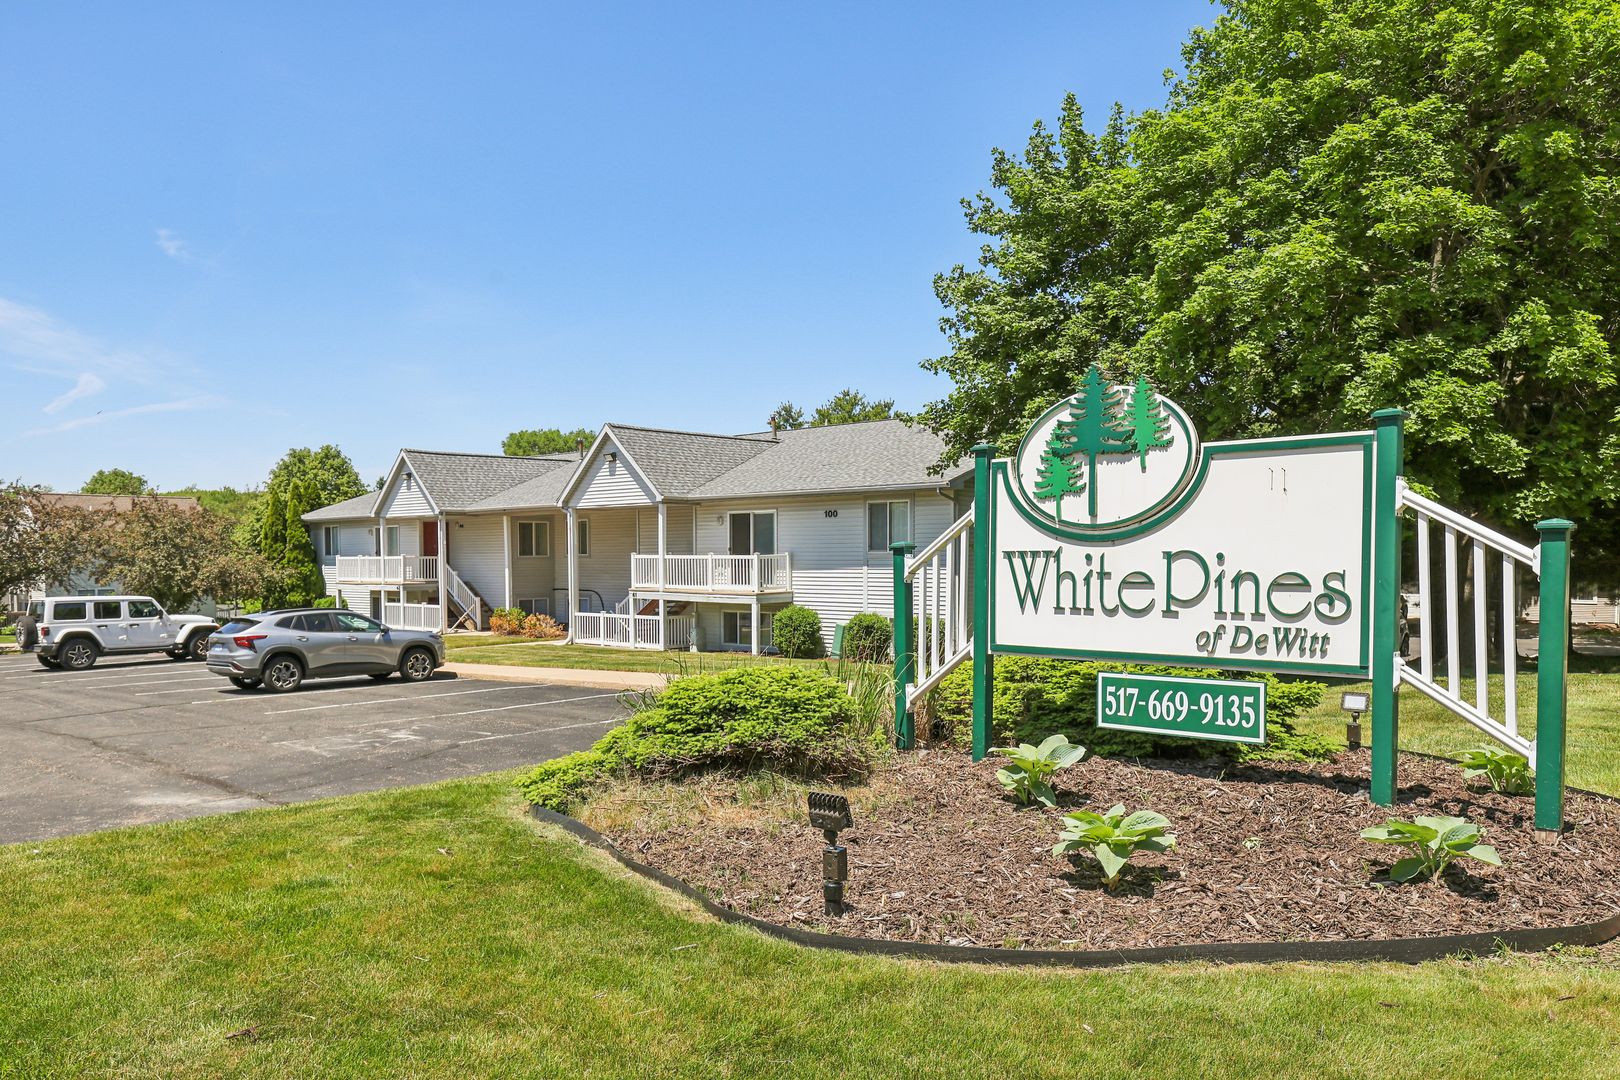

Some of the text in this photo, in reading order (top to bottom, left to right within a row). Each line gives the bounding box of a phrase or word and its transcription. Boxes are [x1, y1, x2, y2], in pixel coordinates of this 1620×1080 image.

[824, 509, 838, 518] 100
[1196, 624, 1227, 657] of
[1104, 685, 1256, 729] 517-669-9135
